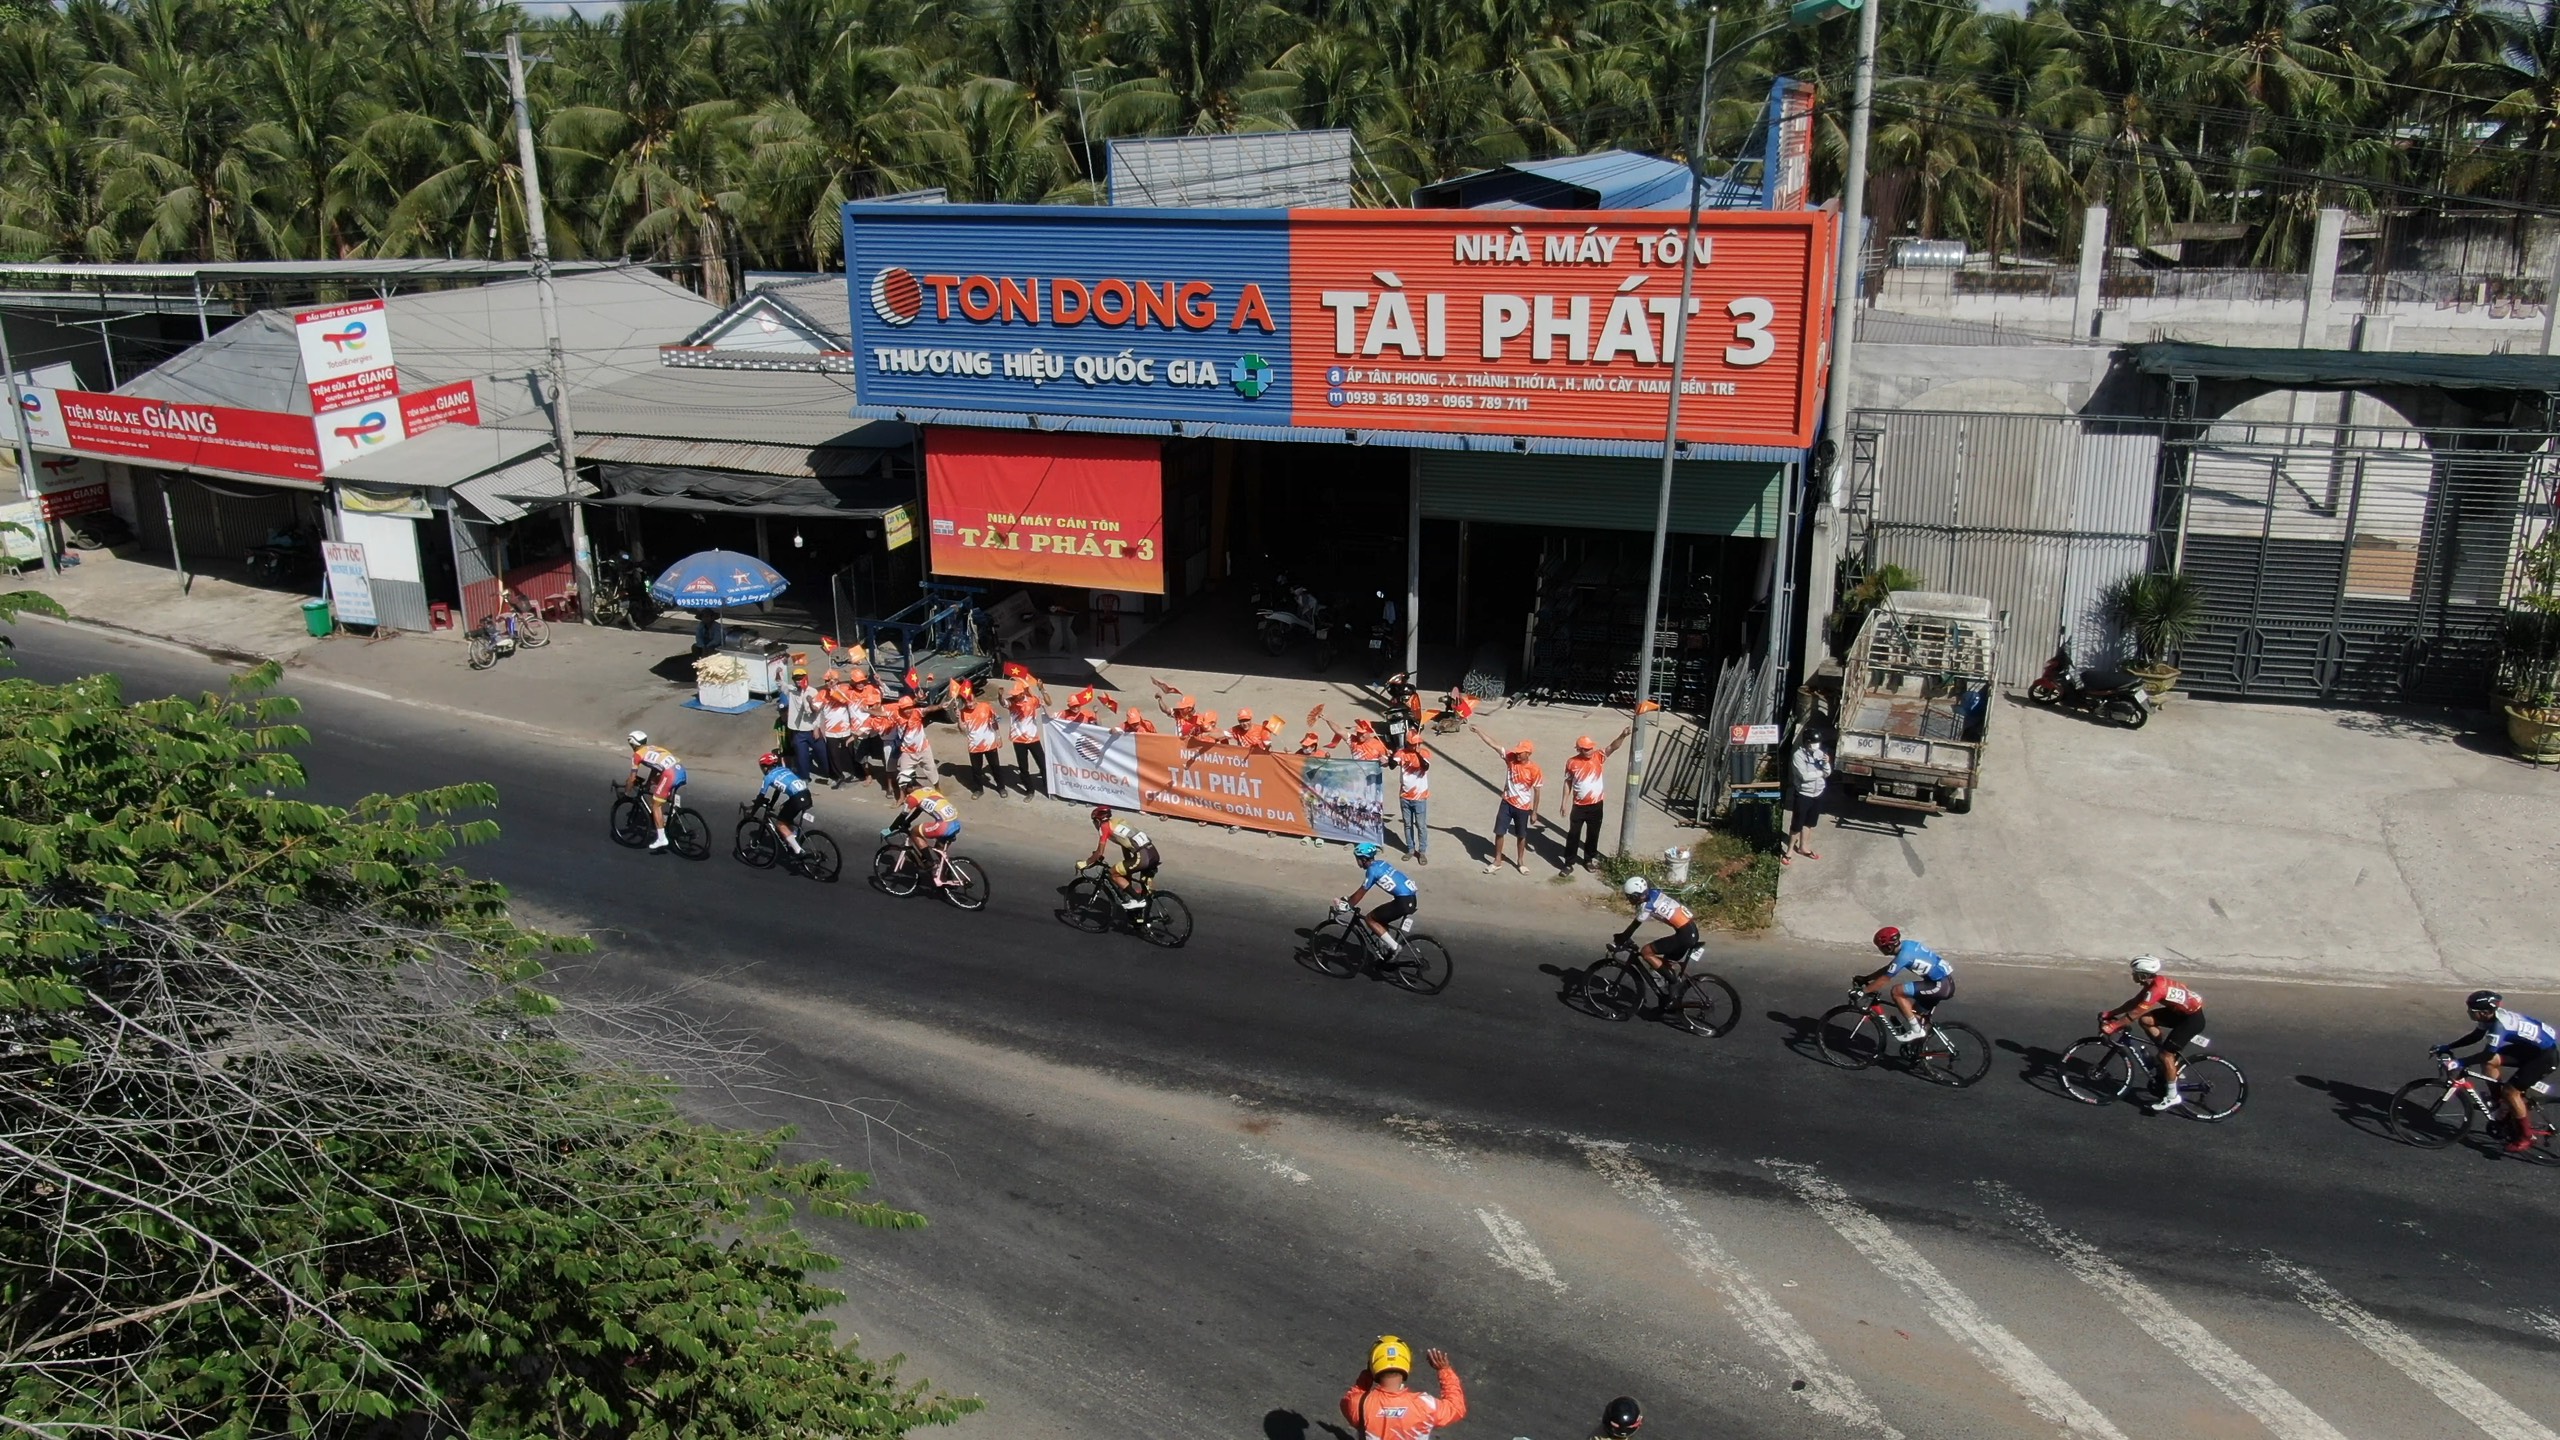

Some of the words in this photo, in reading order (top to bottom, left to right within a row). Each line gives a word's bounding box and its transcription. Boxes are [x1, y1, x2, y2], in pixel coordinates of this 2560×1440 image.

[1455, 226, 1531, 261] NHÀ
[1544, 226, 1620, 263] MÁY
[1636, 228, 1712, 264] TÔN
[923, 274, 1040, 322] TON
[1051, 278, 1217, 329] DONG
[1230, 283, 1276, 331] A
[1322, 272, 1446, 357] TÀI
[1483, 276, 1700, 363] PHÁT
[1725, 297, 1775, 365] 3
[326, 354, 373, 368] TotalEnergies
[874, 348, 993, 375] THƯƠNG
[1003, 348, 1064, 386] HIỆU
[1073, 348, 1155, 385] QUỐC
[1167, 360, 1219, 386] GIA
[313, 384, 331, 396] TIỆM
[332, 380, 348, 392] SỬA
[347, 380, 357, 389] XE
[358, 368, 394, 386] GIANG
[1346, 366, 1362, 382] ẤP
[1367, 368, 1391, 384] TÂN
[1466, 372, 1509, 388] THÀNH
[1608, 376, 1633, 392] CÀY
[1638, 380, 1670, 393] NAM
[1680, 376, 1706, 394] BẾN
[1711, 382, 1736, 396] TRE
[436, 391, 470, 410] GIANG
[1346, 391, 1376, 404] 0939
[1382, 392, 1403, 406] 361
[1406, 393, 1430, 407] 939
[1442, 394, 1474, 409] 0965
[1479, 396, 1502, 410] 789
[1506, 396, 1528, 411] 711
[64, 404, 94, 421] TIỆM
[96, 406, 122, 424] SỬA
[124, 412, 142, 426] XE
[142, 406, 218, 434] GIANG
[73, 486, 104, 500] GIANG
[987, 512, 1016, 525] NHÀ
[1020, 514, 1052, 528] MÁY
[1091, 518, 1120, 532] TÔN
[958, 526, 1020, 550] TÀI
[1029, 532, 1128, 559] PHÁT
[1137, 538, 1154, 561] 3
[1180, 749, 1202, 762] NHÀ
[1204, 752, 1225, 766] MÁY
[1226, 755, 1249, 768] TÔN
[1053, 762, 1078, 778] TON
[1082, 768, 1118, 785] DONG
[1121, 776, 1130, 787] A
[1168, 764, 1202, 791] TÀI
[1208, 771, 1262, 799] PHÁT
[1145, 788, 1180, 804] CHÀO
[1184, 795, 1222, 812] MỪNG
[1226, 802, 1262, 818] ĐOÀN
[1266, 810, 1296, 822] ĐUA
[2168, 987, 2185, 1002] 82
